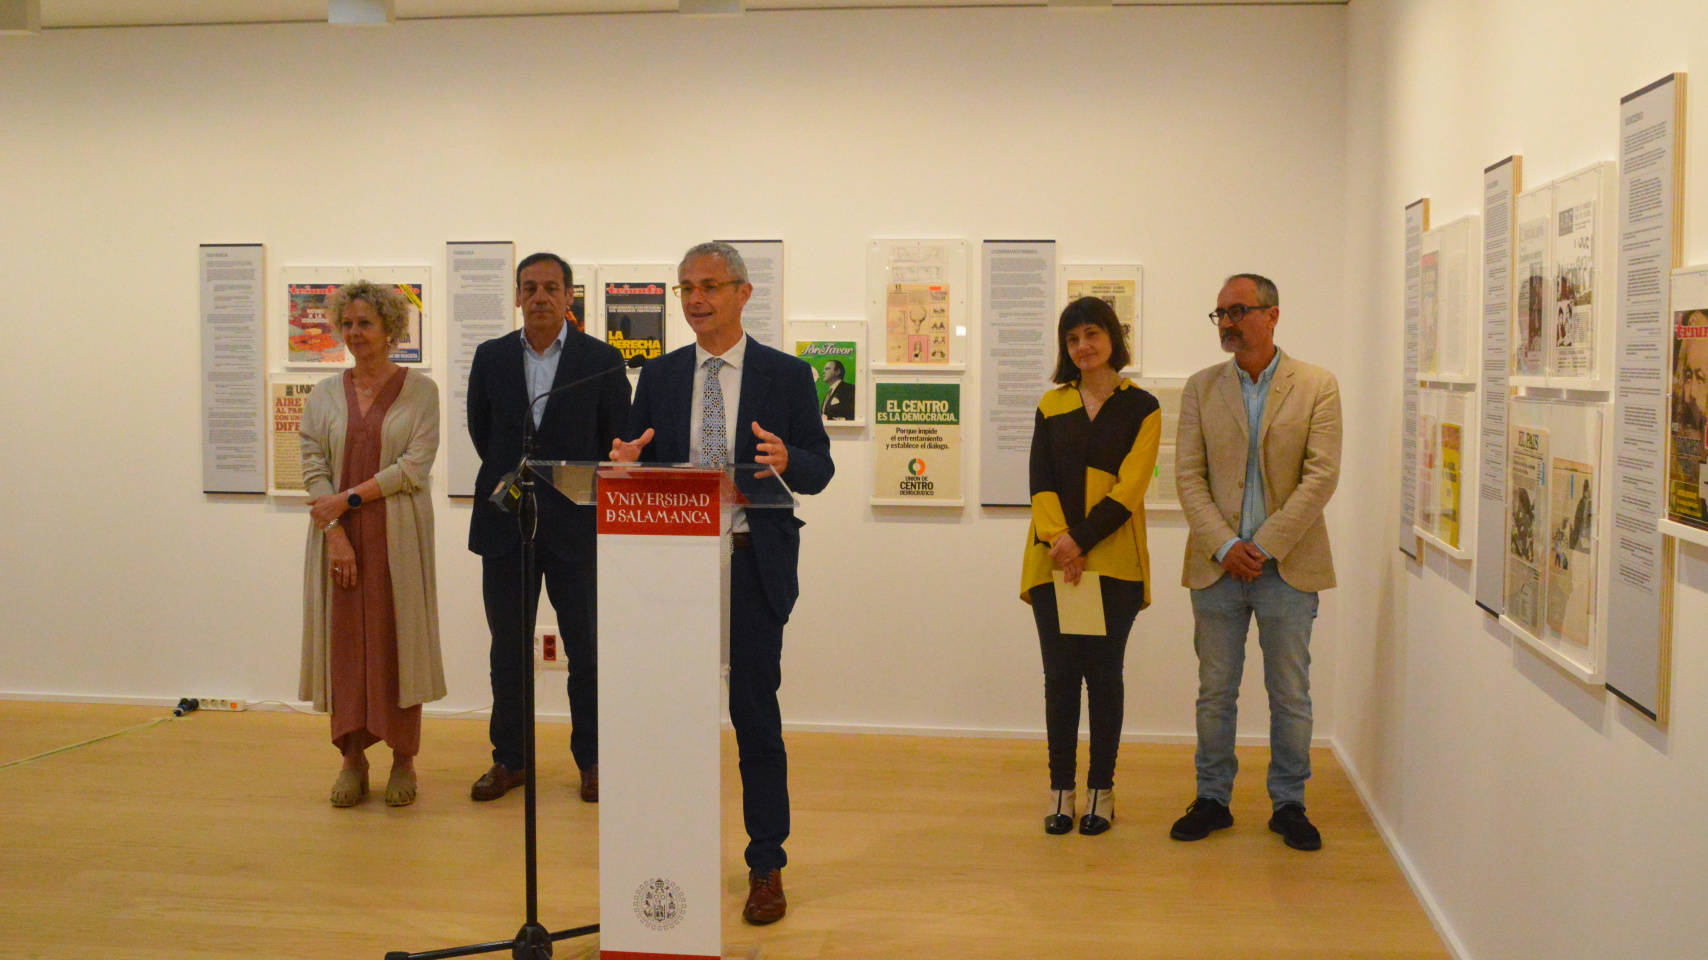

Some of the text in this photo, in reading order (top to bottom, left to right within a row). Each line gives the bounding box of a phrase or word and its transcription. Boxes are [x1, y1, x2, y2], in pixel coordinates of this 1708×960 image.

[289, 284, 338, 295] triunf
[606, 283, 664, 295] triunfo
[608, 330, 623, 340] LA
[608, 339, 661, 350] DERECHA
[818, 342, 854, 356] Favor
[620, 348, 662, 360] ALVAJE
[275, 398, 302, 407] AIRE
[886, 400, 949, 413] EL CENTRO
[877, 412, 957, 422] ES LA DEMOCRACIA.
[275, 421, 301, 431] DIFE
[896, 427, 917, 435] Porque
[900, 481, 934, 490] CENTRO
[618, 509, 711, 524] SALAMANCA
